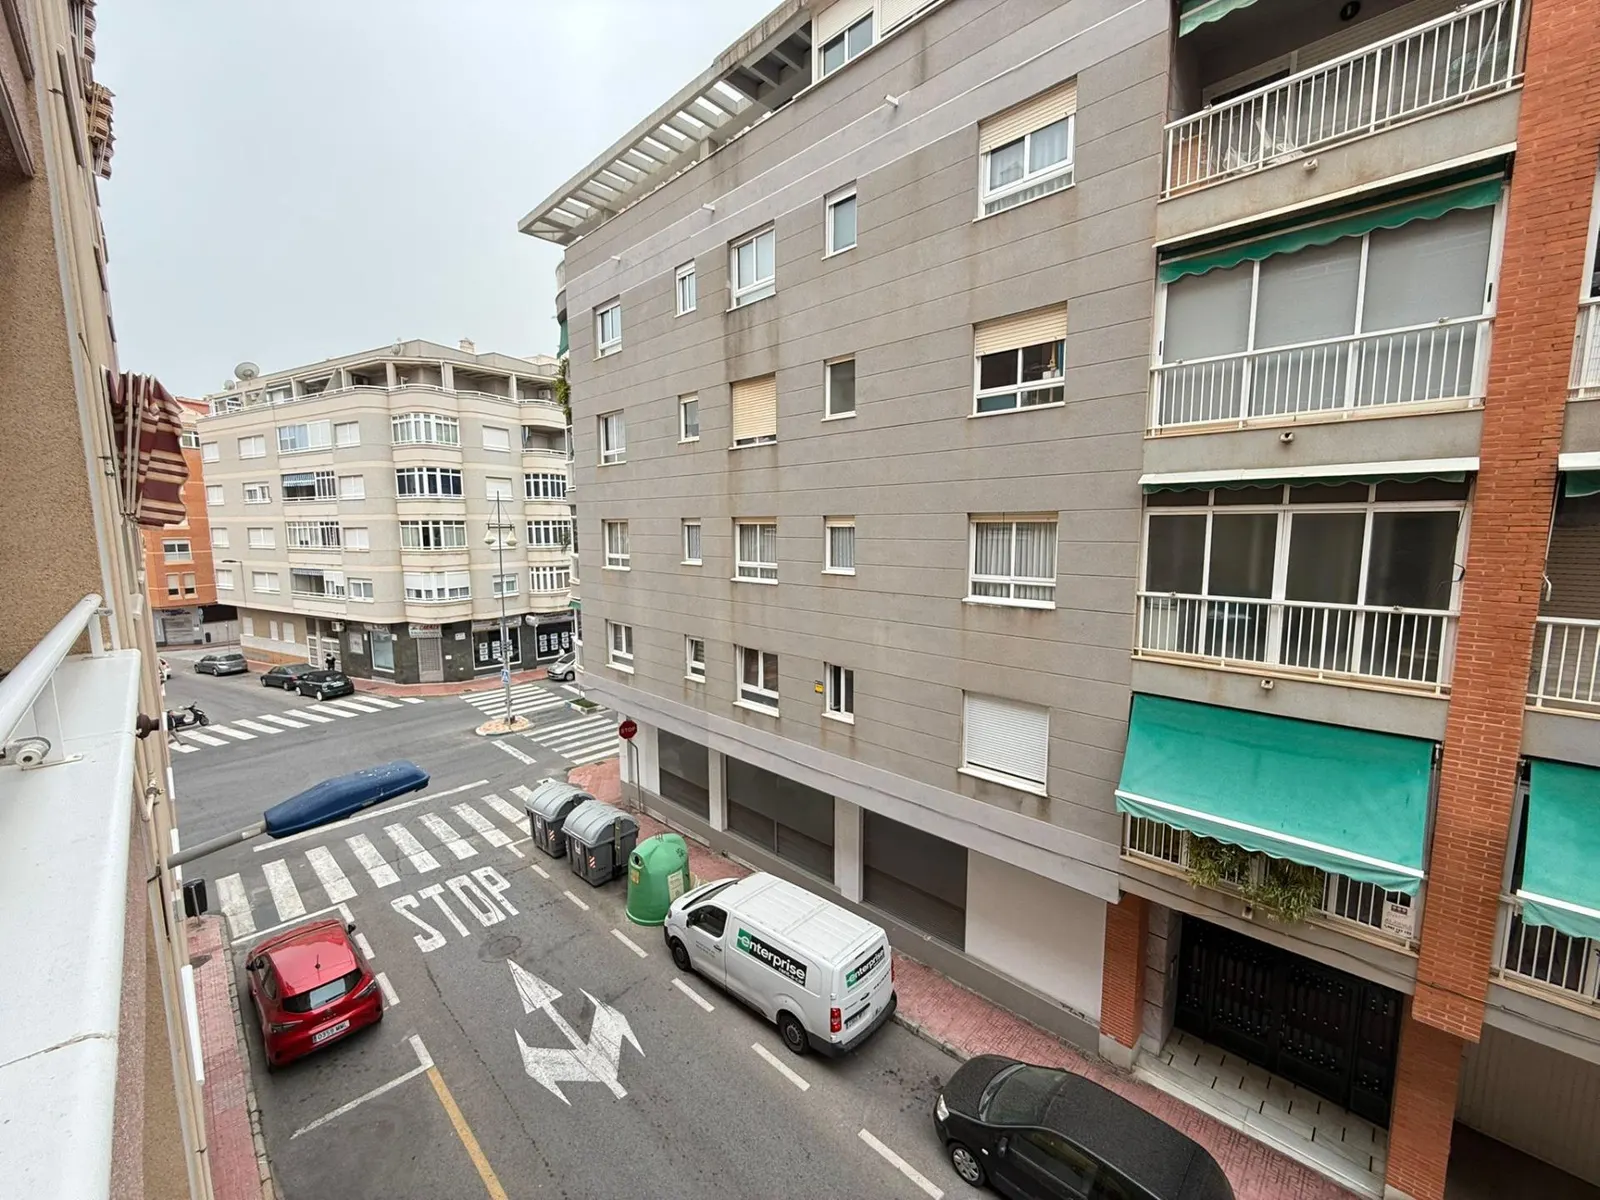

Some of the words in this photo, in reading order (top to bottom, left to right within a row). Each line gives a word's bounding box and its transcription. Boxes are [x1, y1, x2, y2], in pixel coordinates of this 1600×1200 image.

[620, 726, 636, 734] STOP
[390, 865, 520, 952] STOP
[737, 935, 806, 980] enterprise
[846, 949, 885, 984] enterprise
